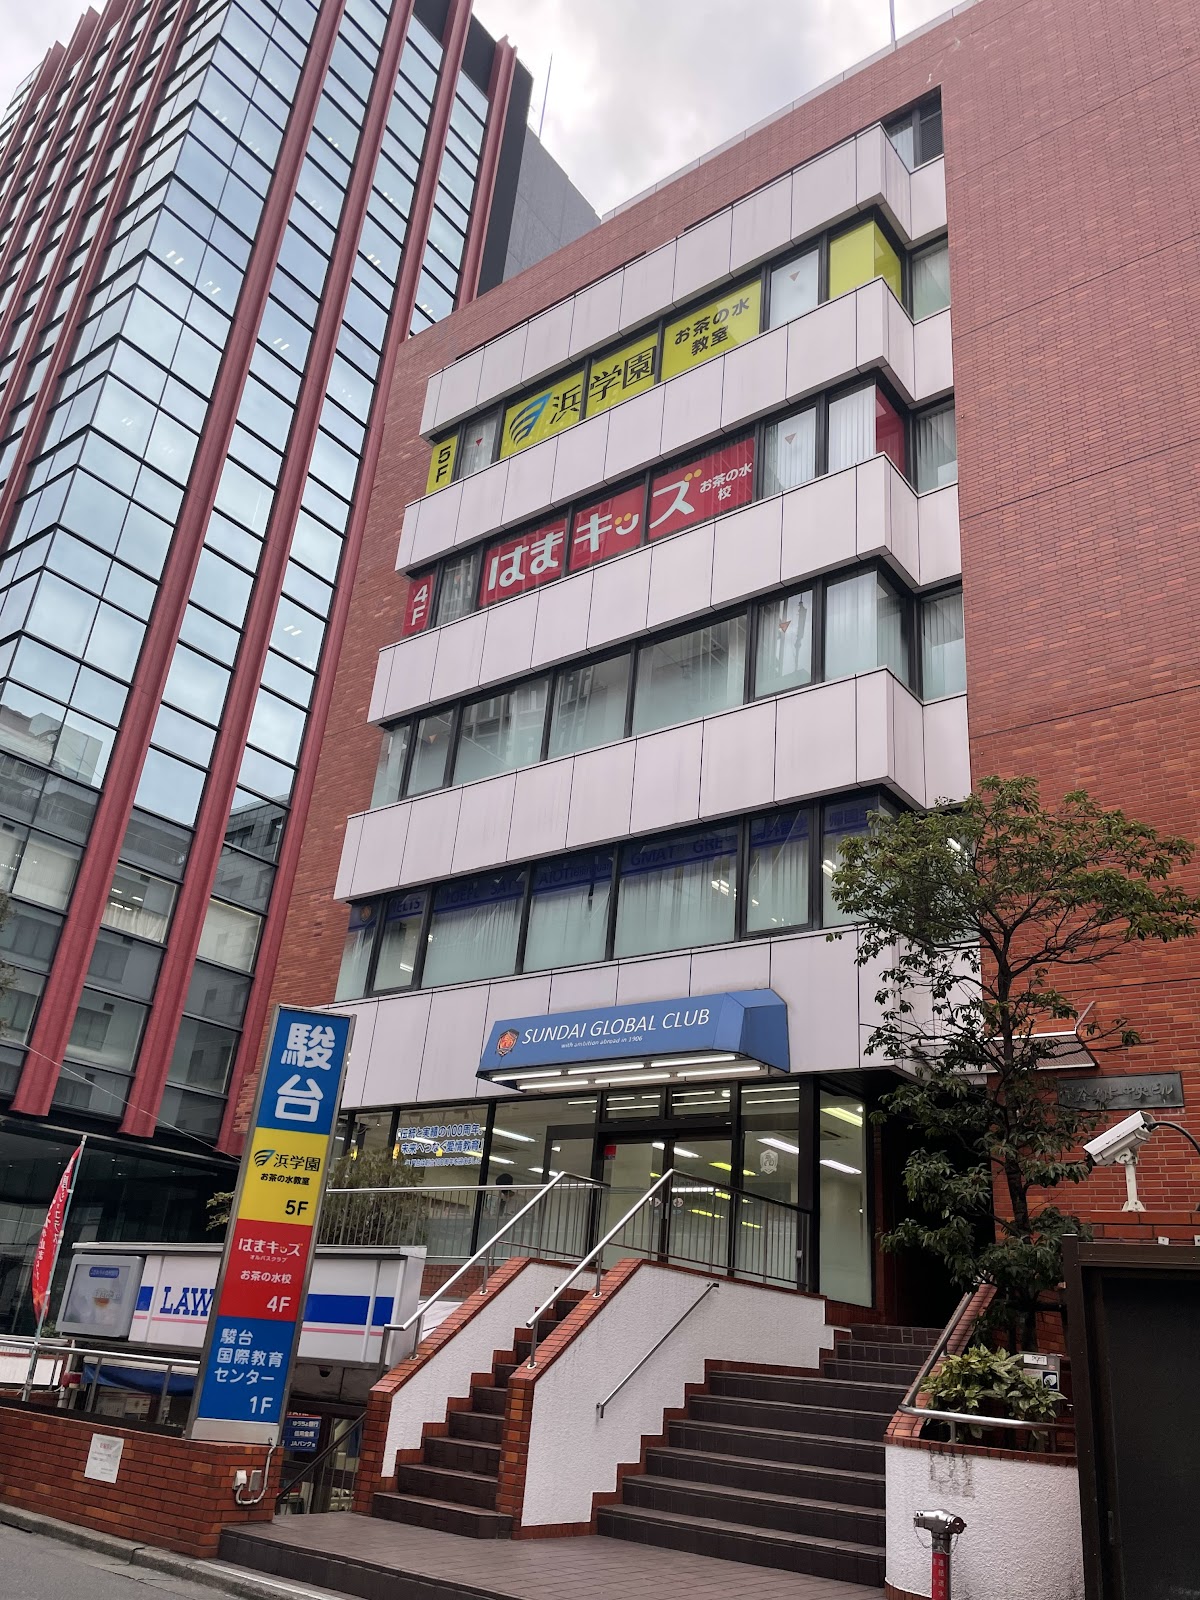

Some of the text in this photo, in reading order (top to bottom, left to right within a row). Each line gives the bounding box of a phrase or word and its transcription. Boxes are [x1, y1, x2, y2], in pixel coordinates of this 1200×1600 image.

[675, 297, 749, 345] お茶の水
[691, 325, 728, 356] 教室
[549, 345, 657, 425] 浜学園
[435, 445, 451, 484] 5F
[700, 462, 752, 493] お茶の水
[717, 485, 732, 501] 校
[486, 468, 704, 591] はまキッズ
[411, 583, 428, 627] 4F
[522, 1008, 710, 1044] SUNDAI GLOBAL CLUB
[561, 1041, 574, 1049] with
[275, 1022, 335, 1122] 駿台
[274, 1153, 321, 1172] 浜学園
[261, 1173, 310, 1186] お茶の水教室
[285, 1199, 309, 1216] 5F
[238, 1237, 303, 1257] はまキッズ
[240, 1269, 292, 1284] お茶の水校
[266, 1295, 291, 1312] 4F
[220, 1328, 253, 1346] 駿台
[216, 1347, 284, 1368] 国際教育
[214, 1367, 275, 1385] センター
[250, 1395, 273, 1414] 1F
